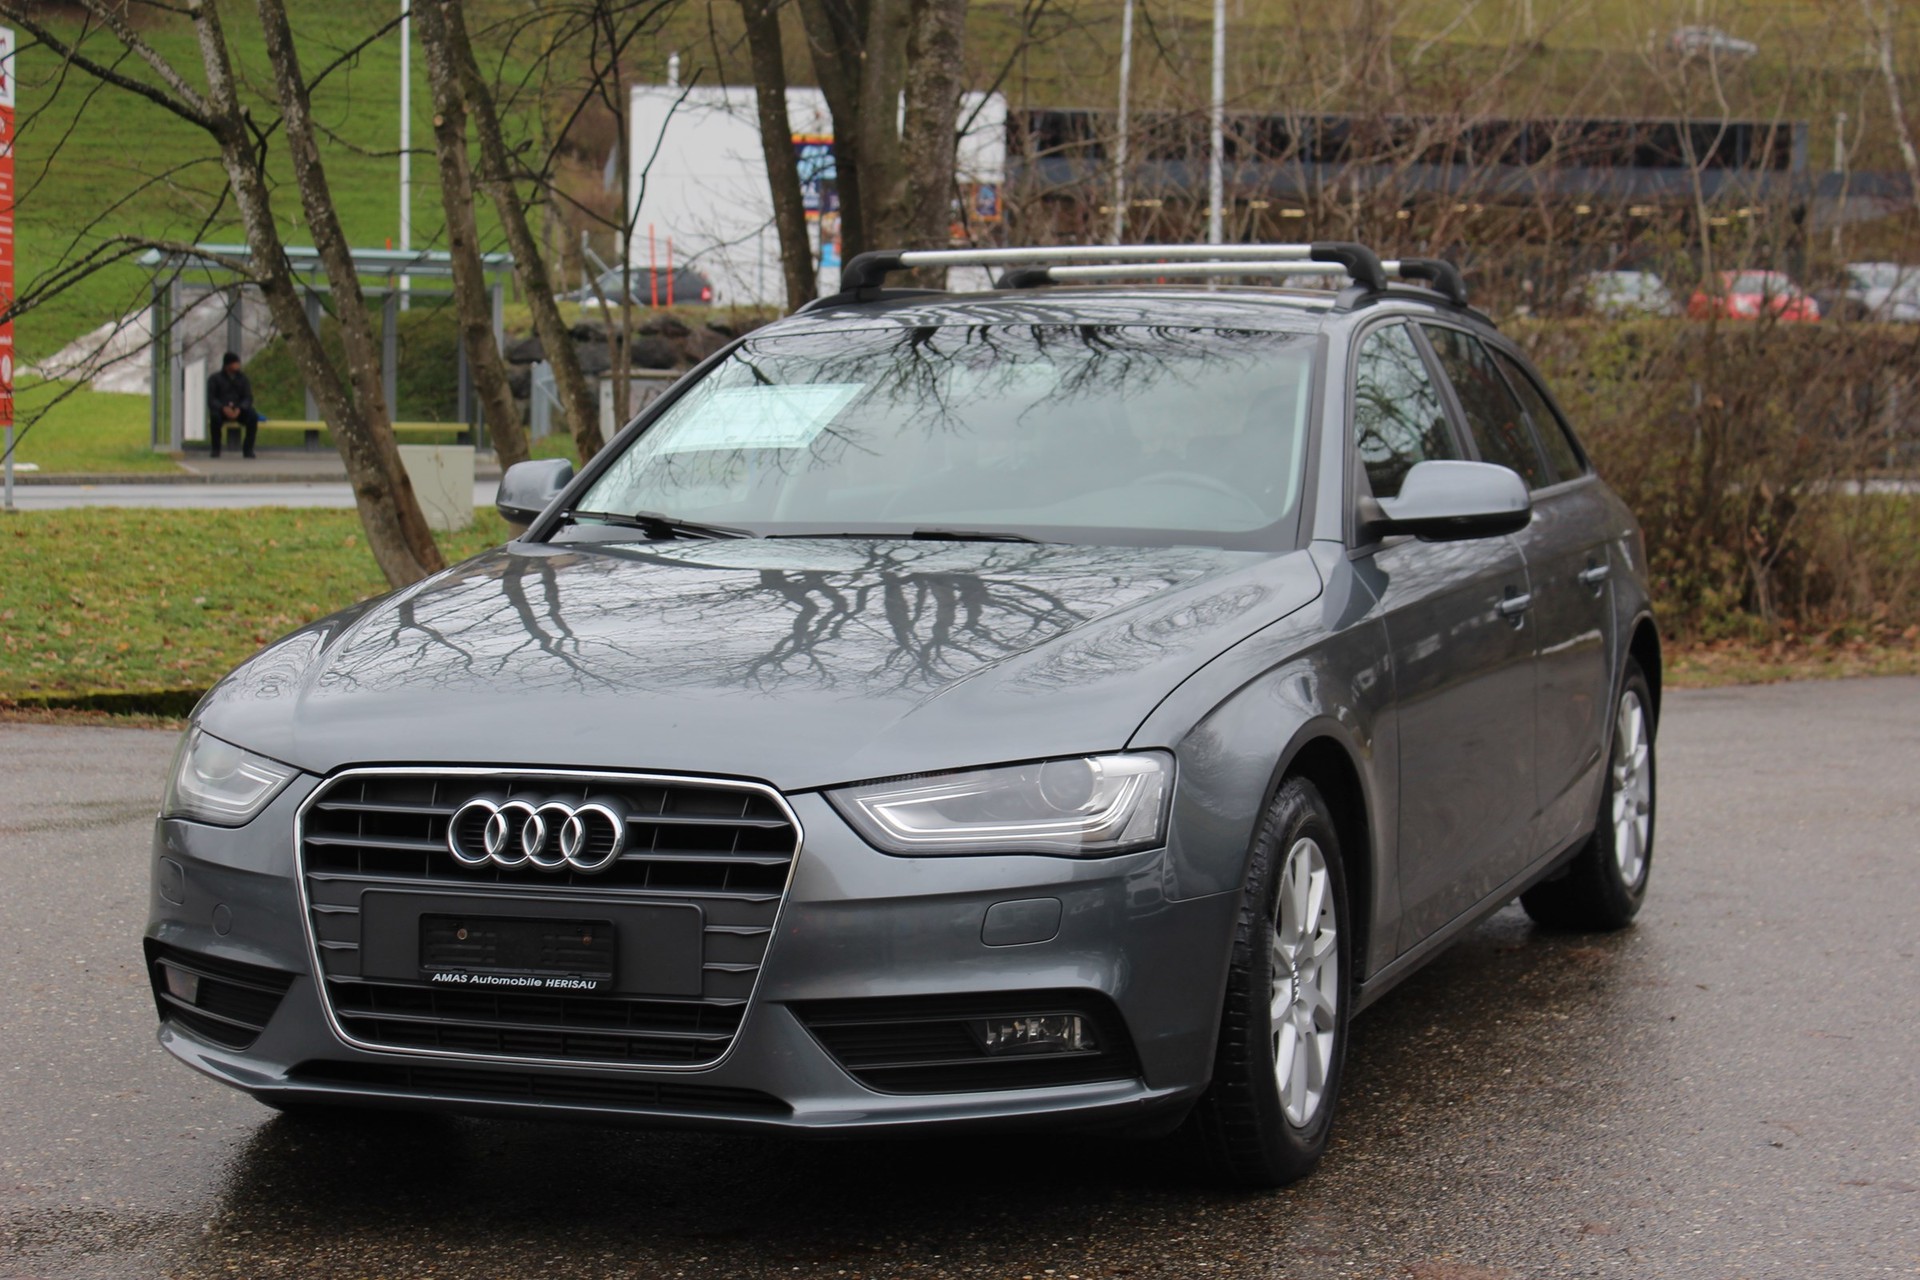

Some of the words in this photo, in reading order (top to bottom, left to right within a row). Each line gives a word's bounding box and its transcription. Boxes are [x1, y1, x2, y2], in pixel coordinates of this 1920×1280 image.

[432, 973, 468, 983] AMAS
[469, 975, 543, 987] Automobile
[545, 979, 597, 989] HERISAU
